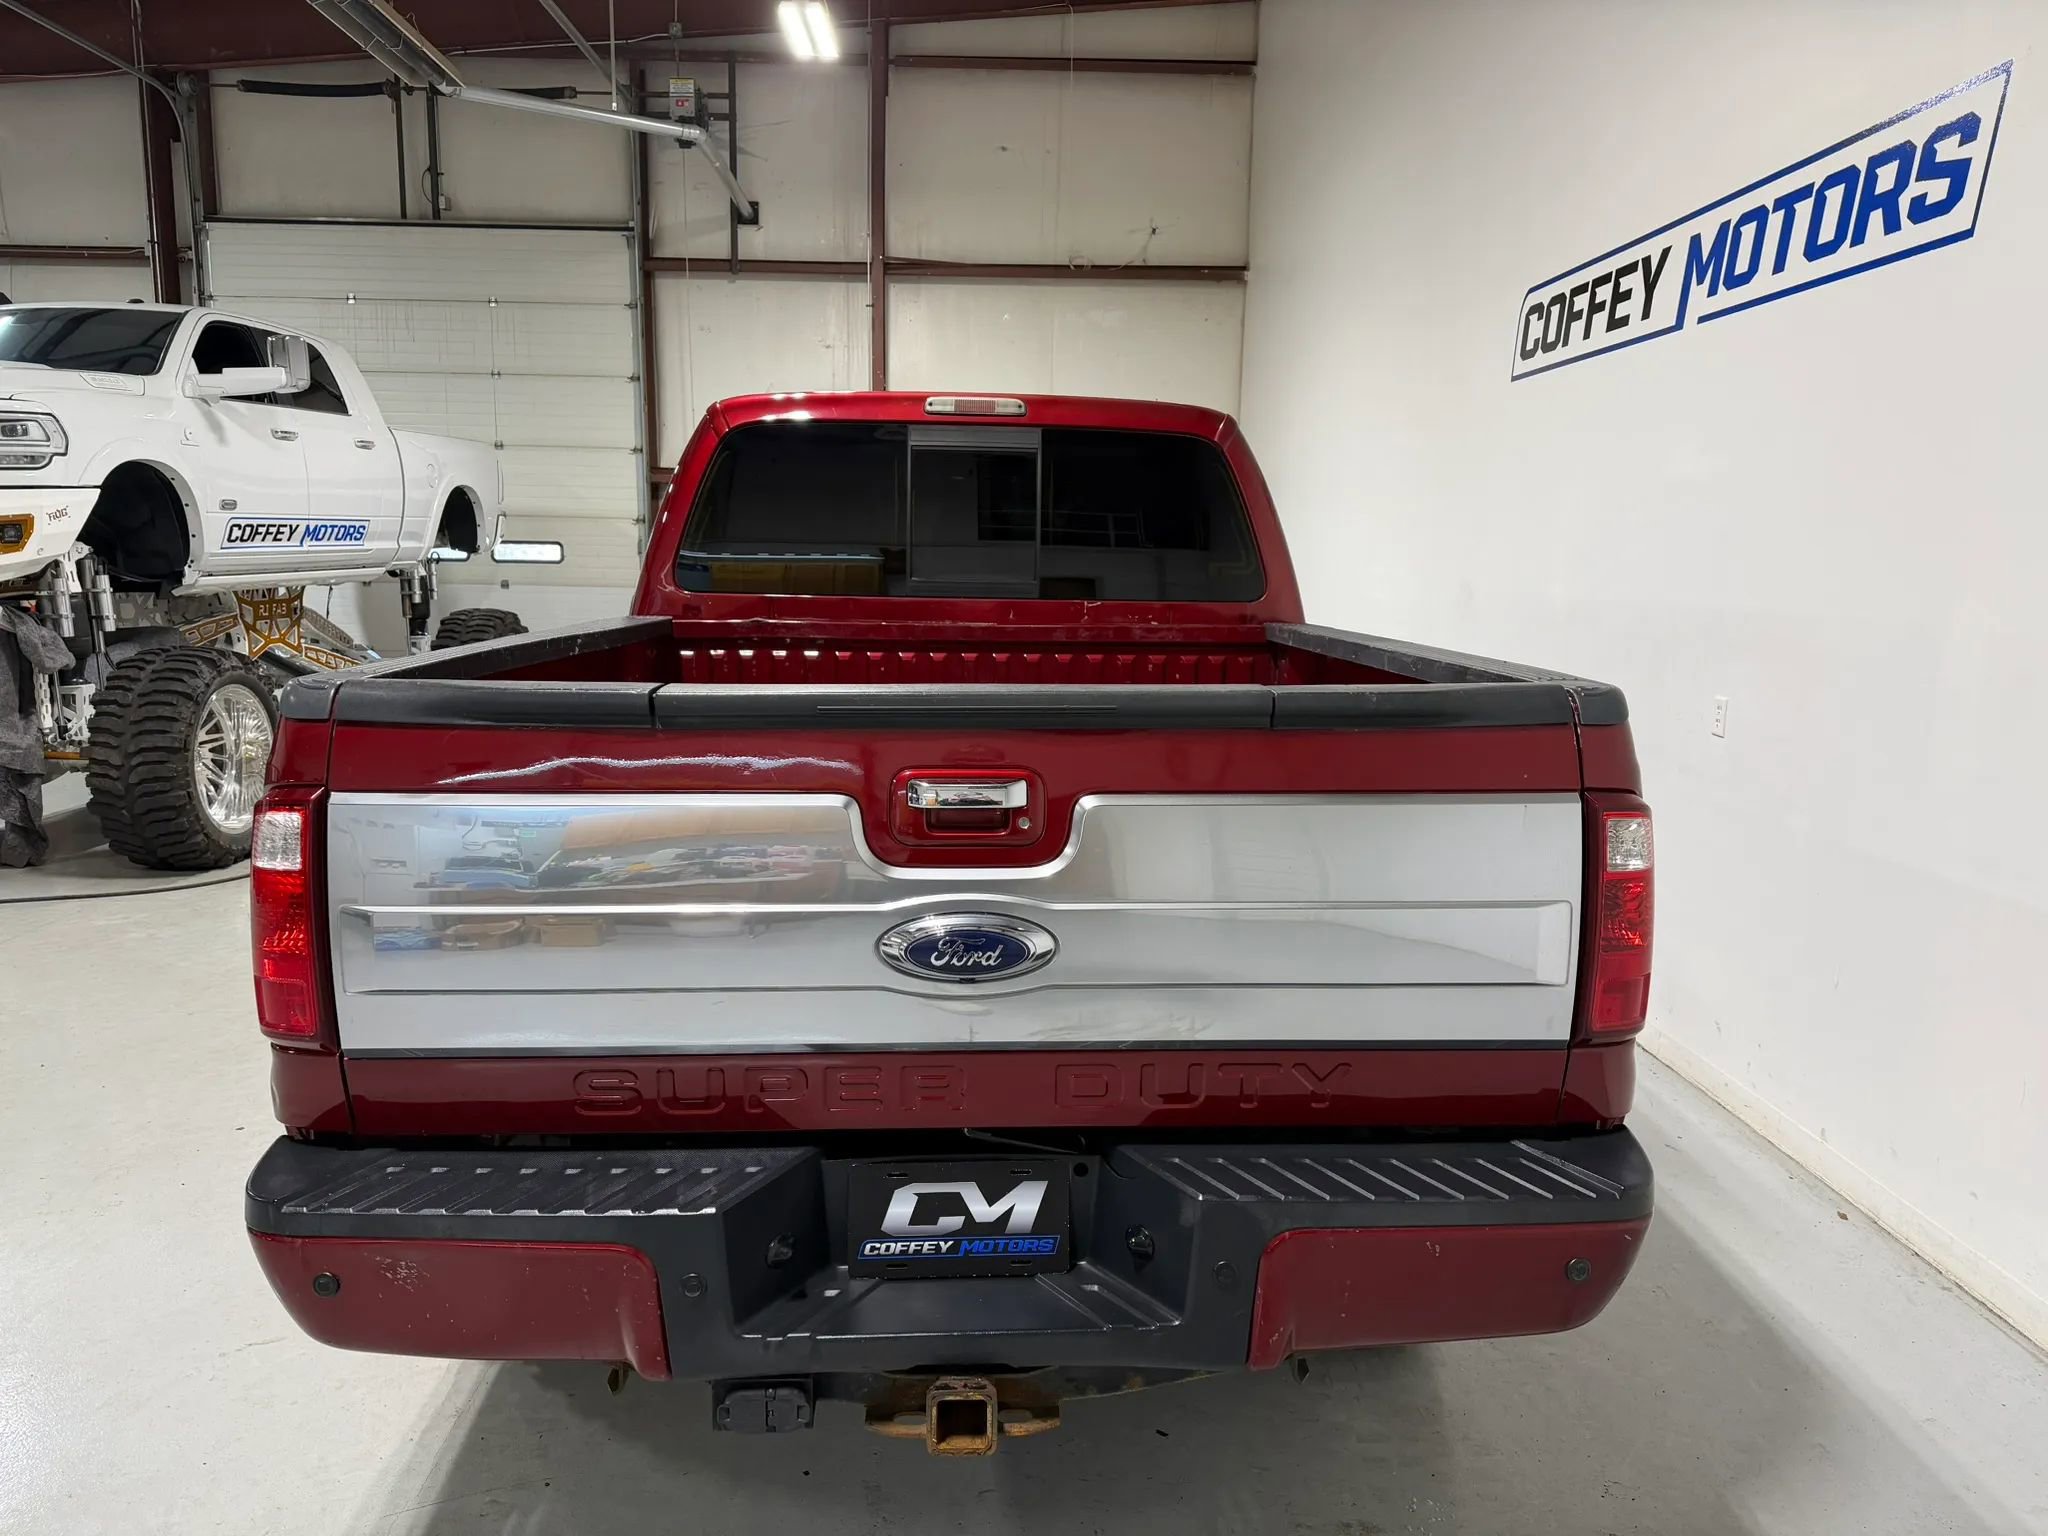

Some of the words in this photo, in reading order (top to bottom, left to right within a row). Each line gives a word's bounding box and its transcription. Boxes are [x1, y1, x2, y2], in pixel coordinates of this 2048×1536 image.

[1520, 245, 1672, 361] COFFEY
[1678, 111, 1981, 325] MOTORS
[226, 523, 300, 543] COFFEY
[301, 523, 366, 546] MOTORS
[930, 936, 1004, 966] Ford
[573, 1065, 968, 1115] SUPER
[1054, 1063, 1352, 1108] DUTY
[880, 1180, 1049, 1237] CM
[864, 1240, 954, 1256] COFFEY
[958, 1239, 1054, 1256] MOTORS
